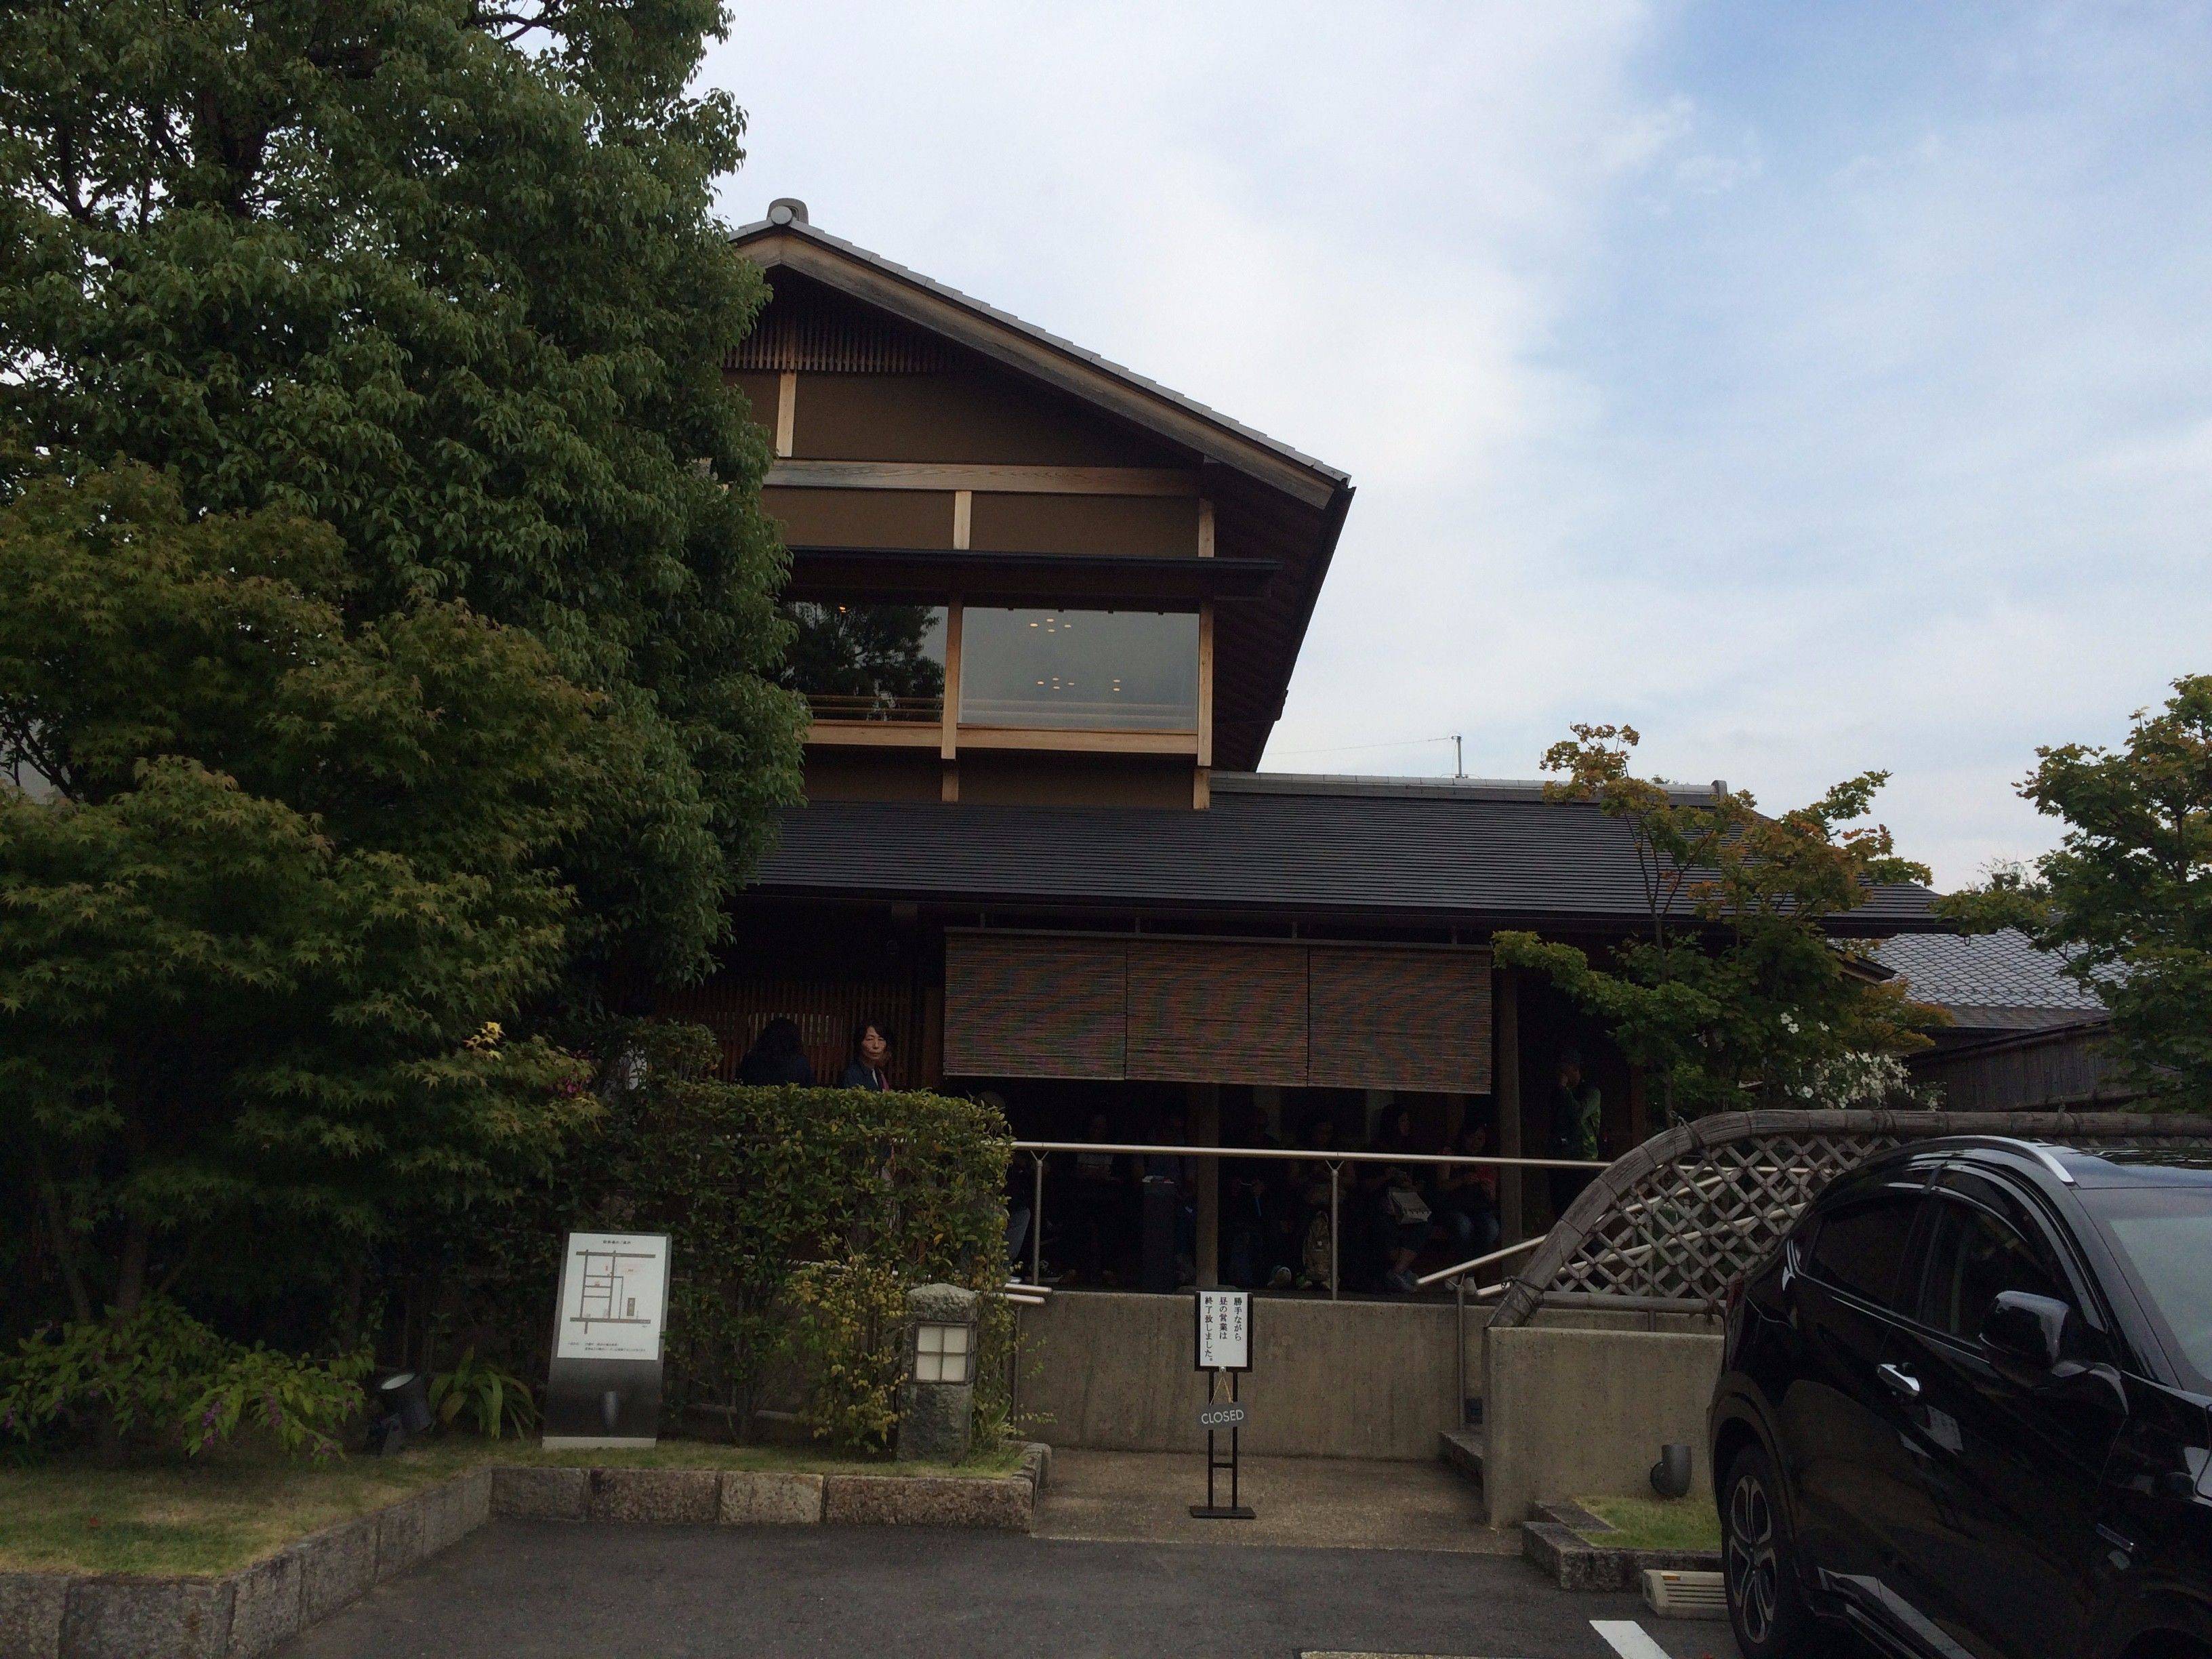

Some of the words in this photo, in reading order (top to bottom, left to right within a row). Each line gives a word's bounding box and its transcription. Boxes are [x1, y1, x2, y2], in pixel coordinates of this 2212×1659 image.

[1204, 1296, 1214, 1361] 終了致しました。
[1218, 1296, 1228, 1340] 昼の営業は
[1233, 1296, 1242, 1341] 勝手ながら
[1201, 1409, 1244, 1425] CLOSED
